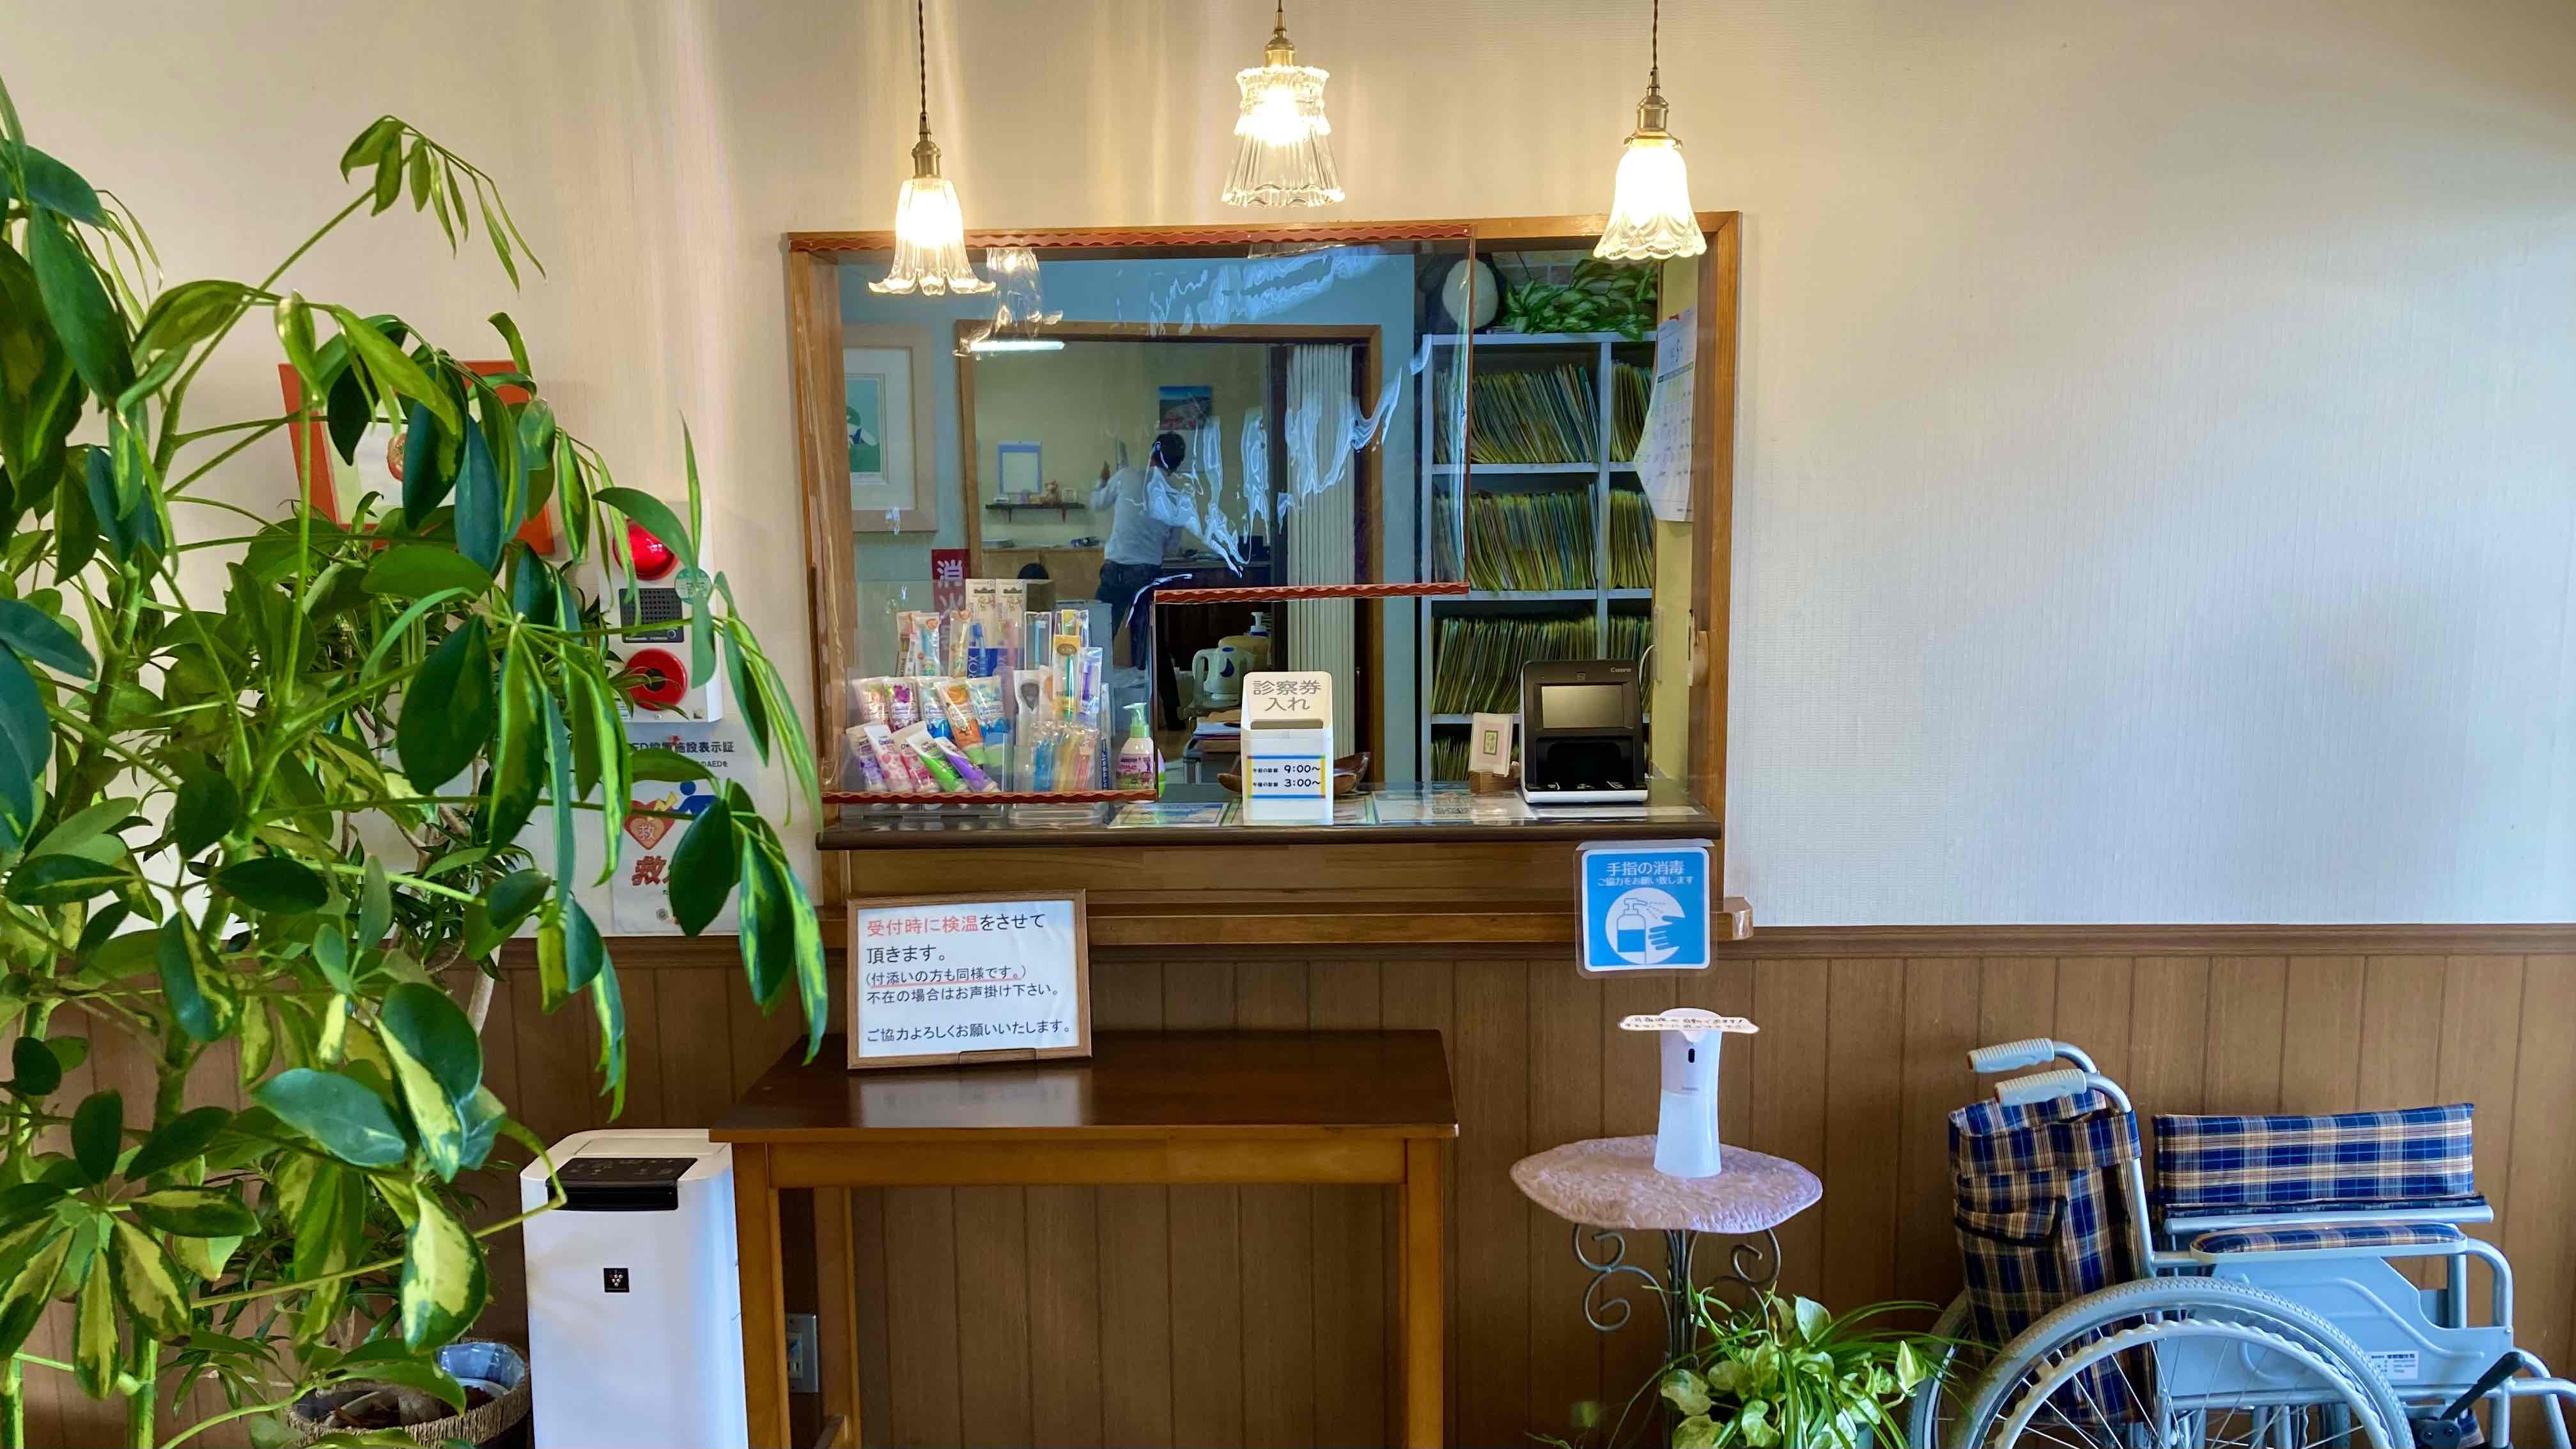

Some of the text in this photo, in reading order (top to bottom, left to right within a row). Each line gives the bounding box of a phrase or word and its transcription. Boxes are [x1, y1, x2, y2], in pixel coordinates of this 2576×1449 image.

[1253, 679, 1321, 695] 診察券
[1264, 697, 1310, 711] 入れ
[632, 741, 734, 754] ED設置施設表示証
[1284, 764, 1321, 774] 9:00～
[1284, 779, 1321, 787] 3:00～
[631, 855, 671, 886] 救
[1606, 860, 1685, 876] 手指の消毒
[867, 913, 1046, 937] 受付時に検温をさせて
[866, 944, 946, 964] 頂きます。
[867, 984, 1059, 1005] 不在の場合はお声掛け下さい。
[867, 1018, 1070, 1042] ご協力よろしくお願いいたします。
